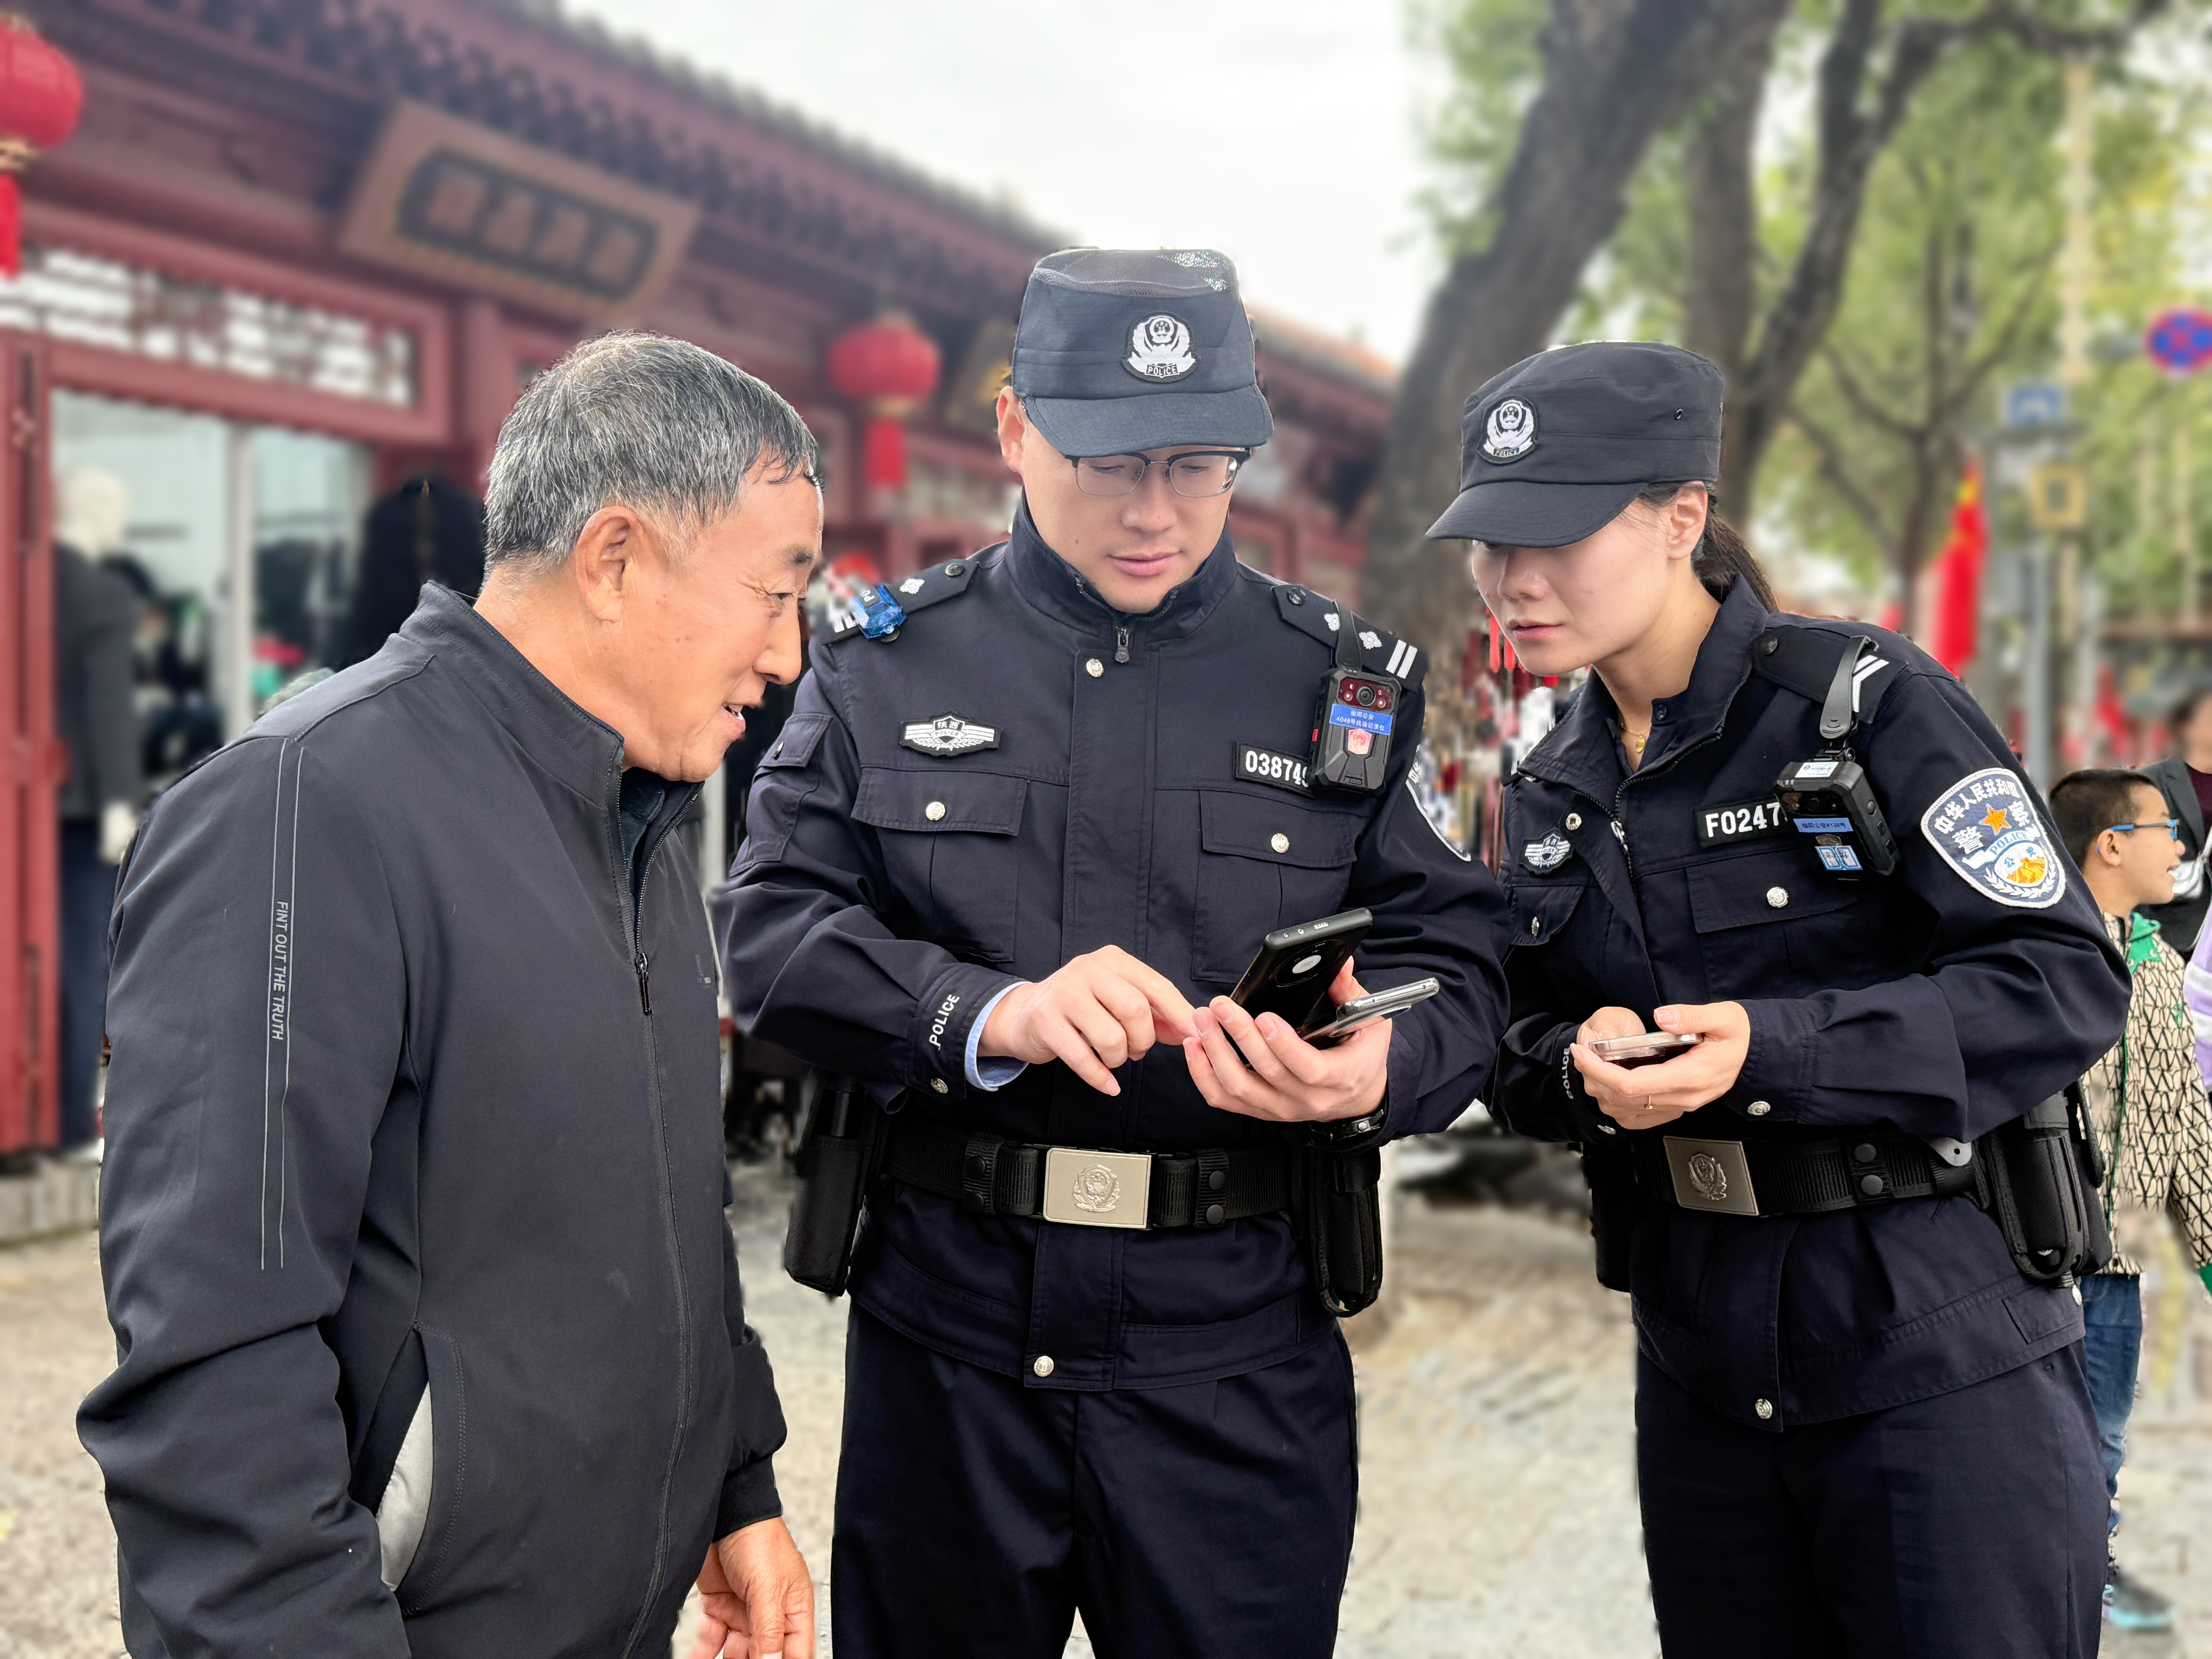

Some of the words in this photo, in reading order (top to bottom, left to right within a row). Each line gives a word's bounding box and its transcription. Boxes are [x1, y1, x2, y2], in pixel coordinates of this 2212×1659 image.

[1148, 366, 1176, 376] POLICE
[1934, 778, 2021, 834] 中华人民共和国
[1989, 832, 2029, 855] POLICE
[276, 901, 289, 932] FINT
[275, 934, 287, 963] OUT
[273, 966, 286, 989] THE
[272, 996, 285, 1040] TRUTH
[929, 994, 960, 1051] POLICE
[1561, 1047, 1574, 1099] POLICE
